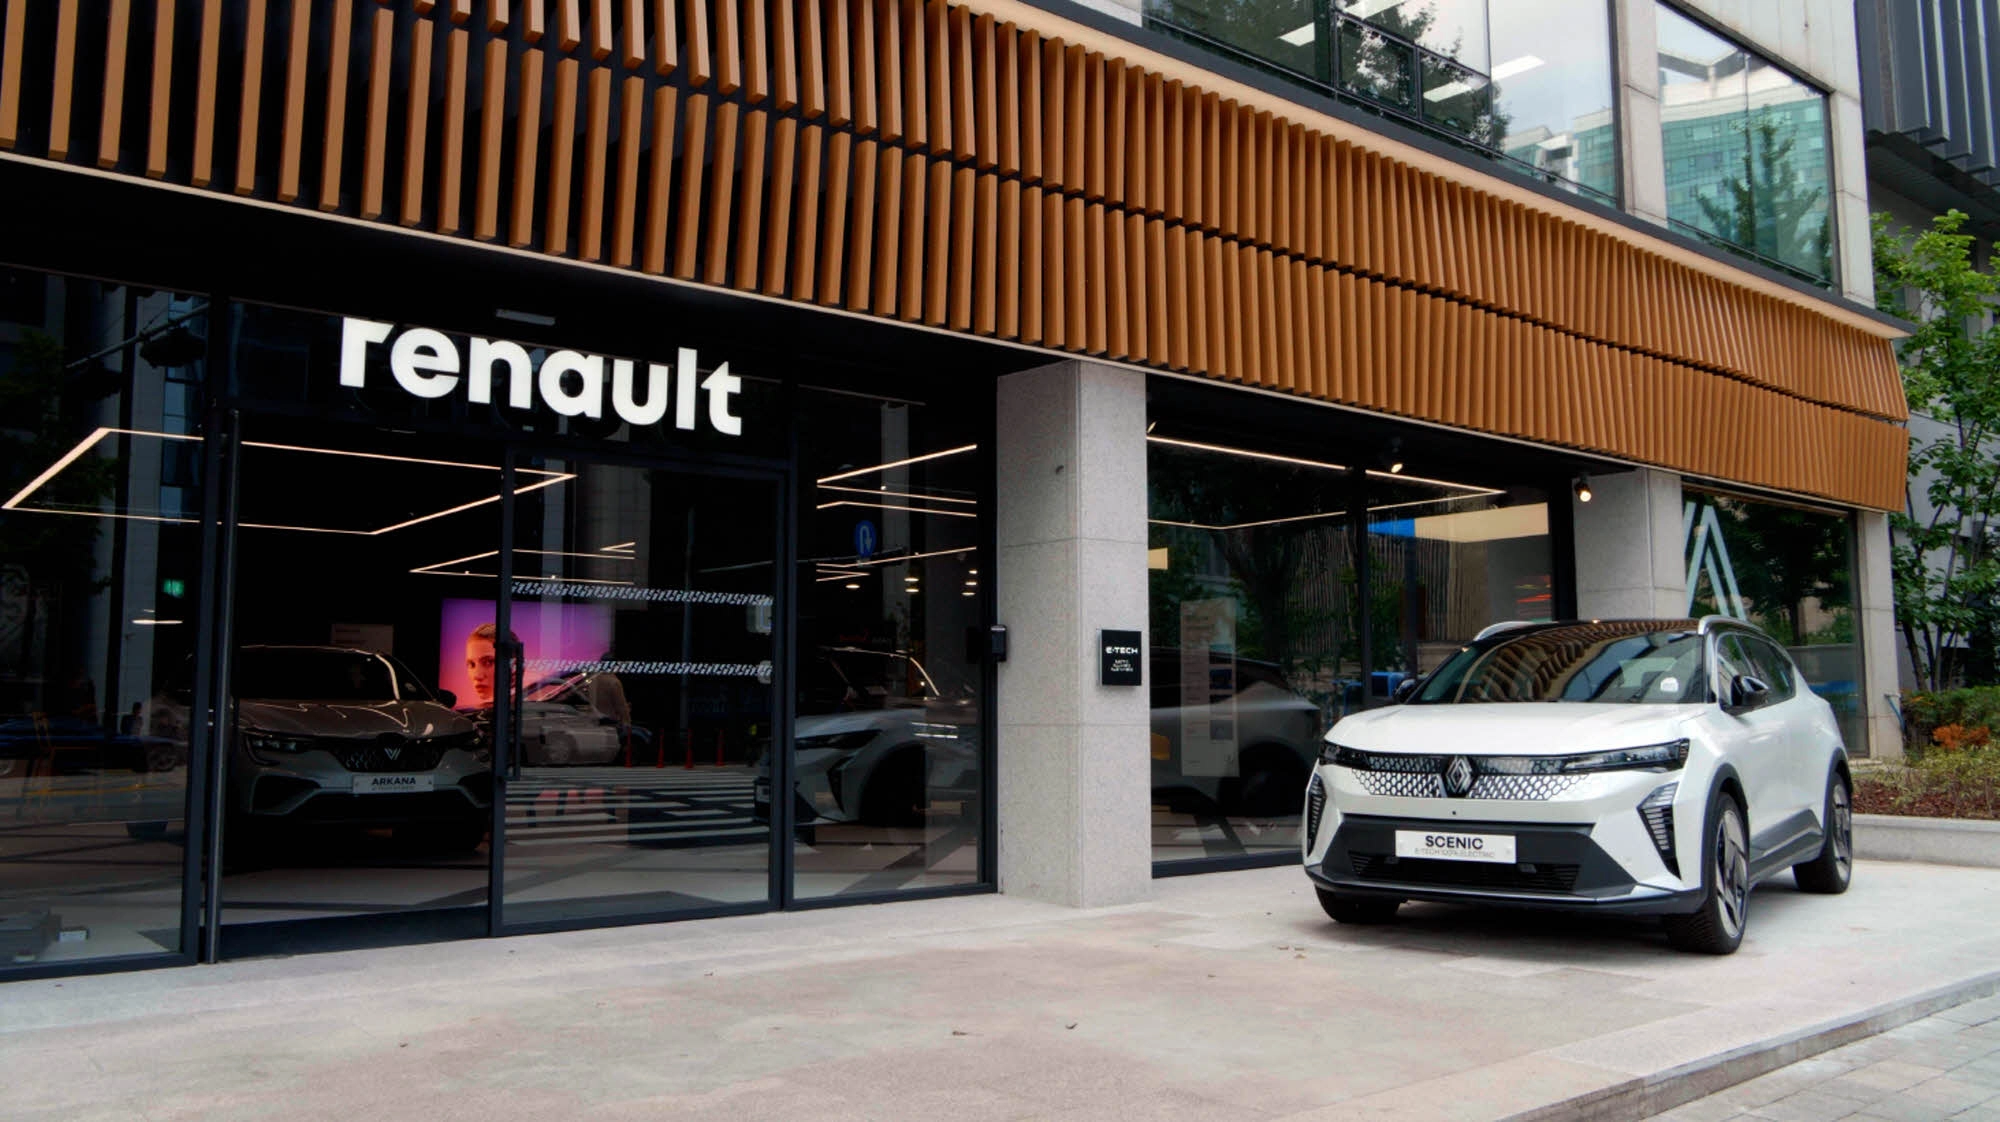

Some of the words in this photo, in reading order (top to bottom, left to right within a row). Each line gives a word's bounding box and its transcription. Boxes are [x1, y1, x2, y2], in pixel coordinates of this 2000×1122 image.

[340, 316, 742, 436] renault
[371, 776, 416, 786] ARKANA
[1425, 835, 1483, 850] SCENIC
